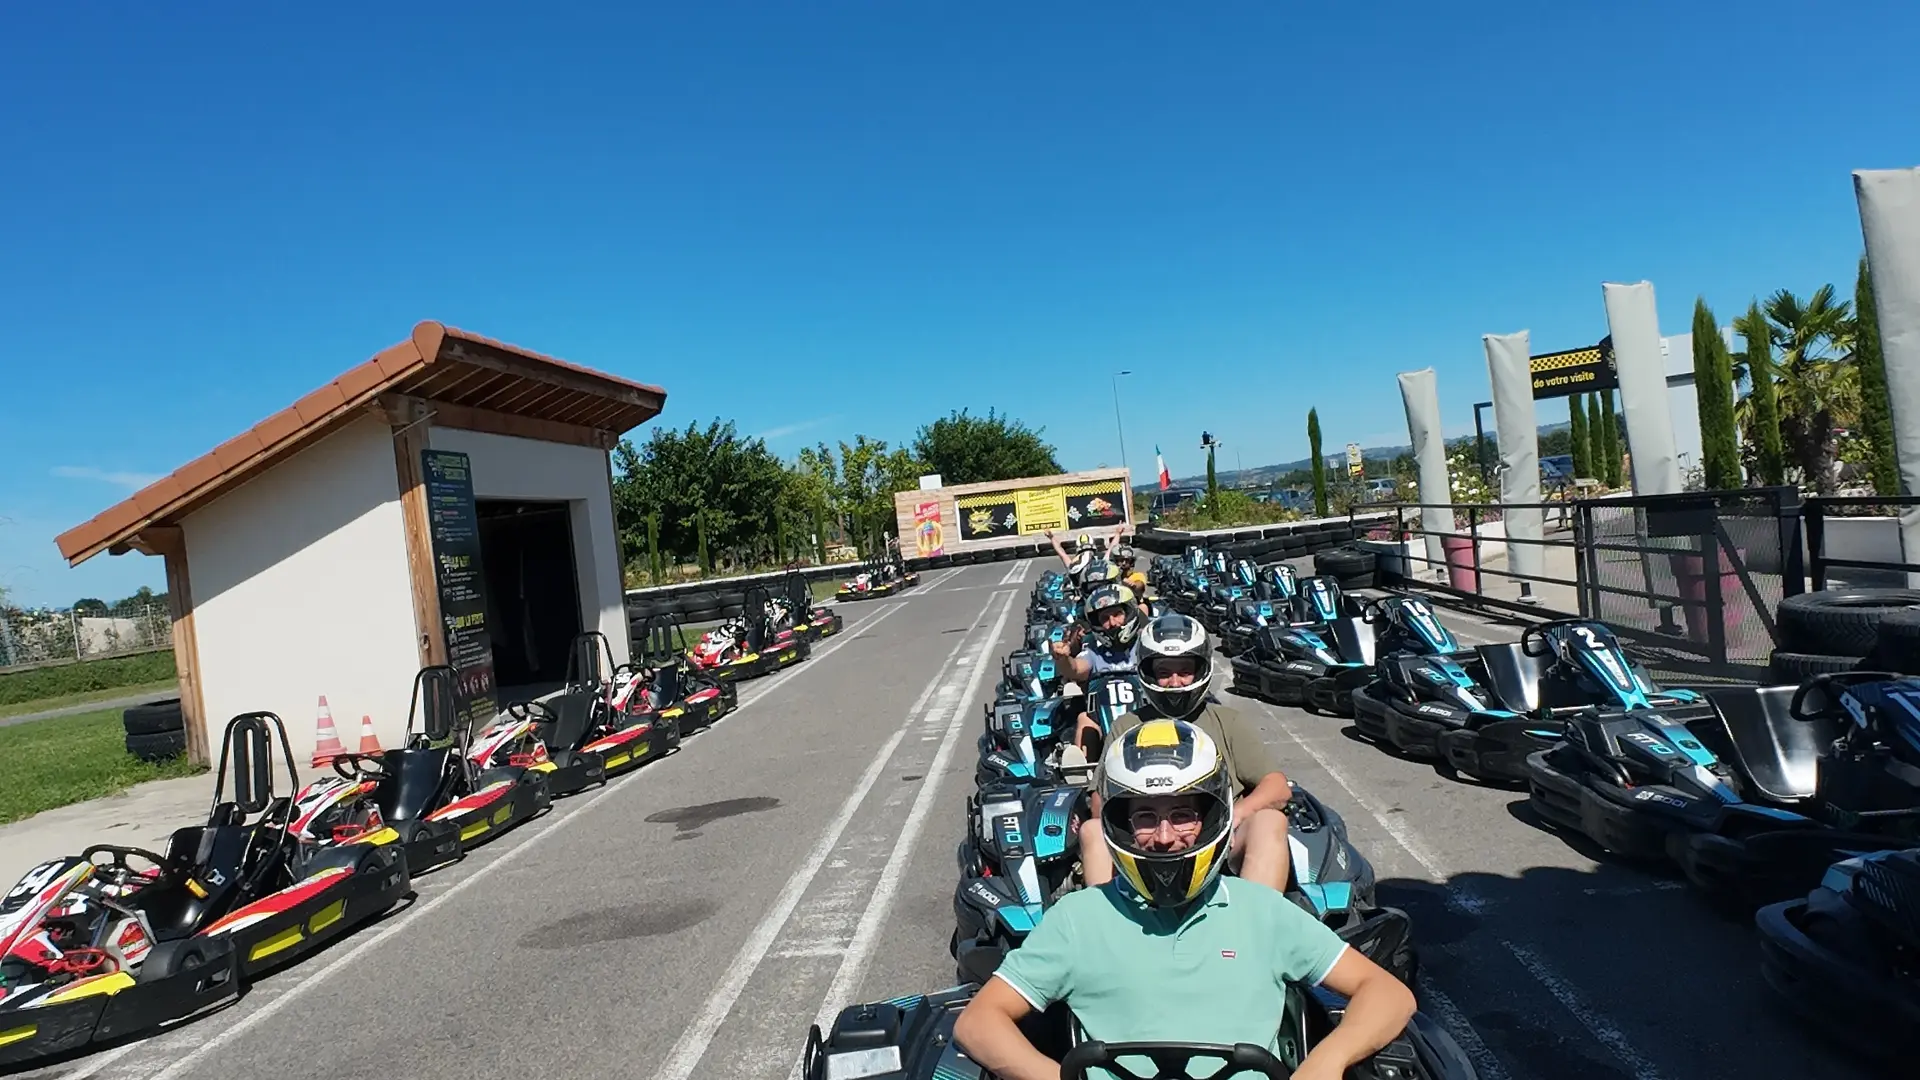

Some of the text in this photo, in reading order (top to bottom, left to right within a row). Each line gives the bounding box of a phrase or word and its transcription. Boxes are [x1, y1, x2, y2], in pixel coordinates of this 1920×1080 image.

[1545, 376, 1569, 387] votre
[1570, 371, 1595, 383] visite
[1274, 566, 1291, 577] 12
[1312, 579, 1326, 591] 5
[1401, 601, 1431, 616] 14
[1575, 627, 1605, 648] 2
[1106, 682, 1135, 704] 16
